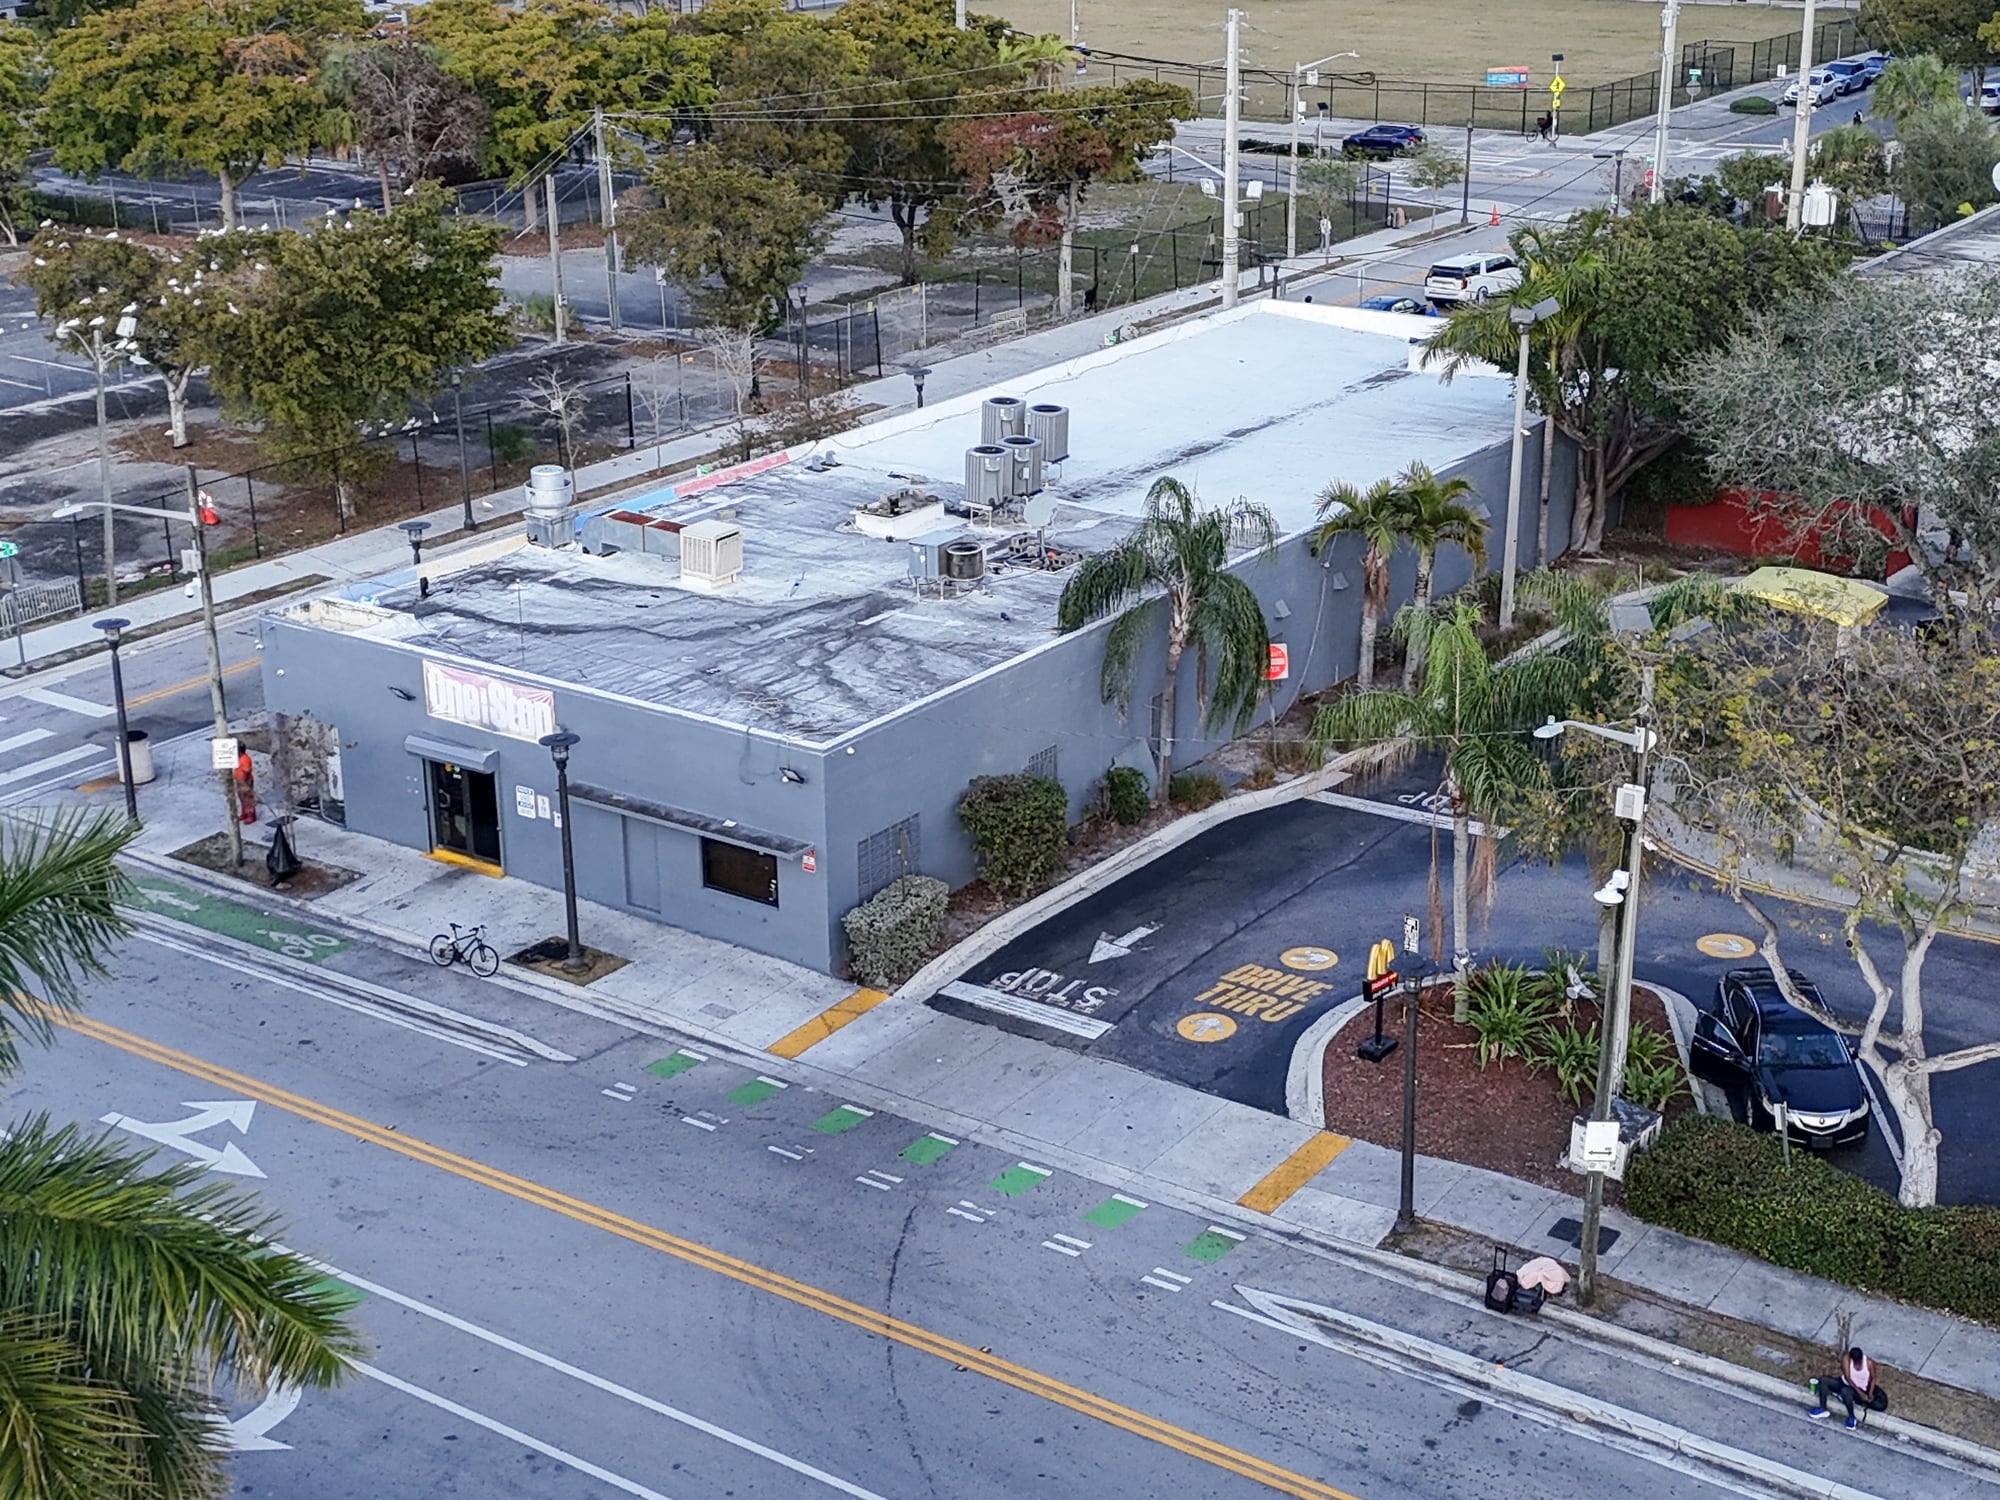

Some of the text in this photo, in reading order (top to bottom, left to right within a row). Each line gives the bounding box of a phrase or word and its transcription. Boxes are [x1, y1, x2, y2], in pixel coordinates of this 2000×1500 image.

[991, 967, 1120, 1013] STOP
[1193, 981, 1306, 1023] THRU
[1220, 963, 1334, 999] DRIVE
